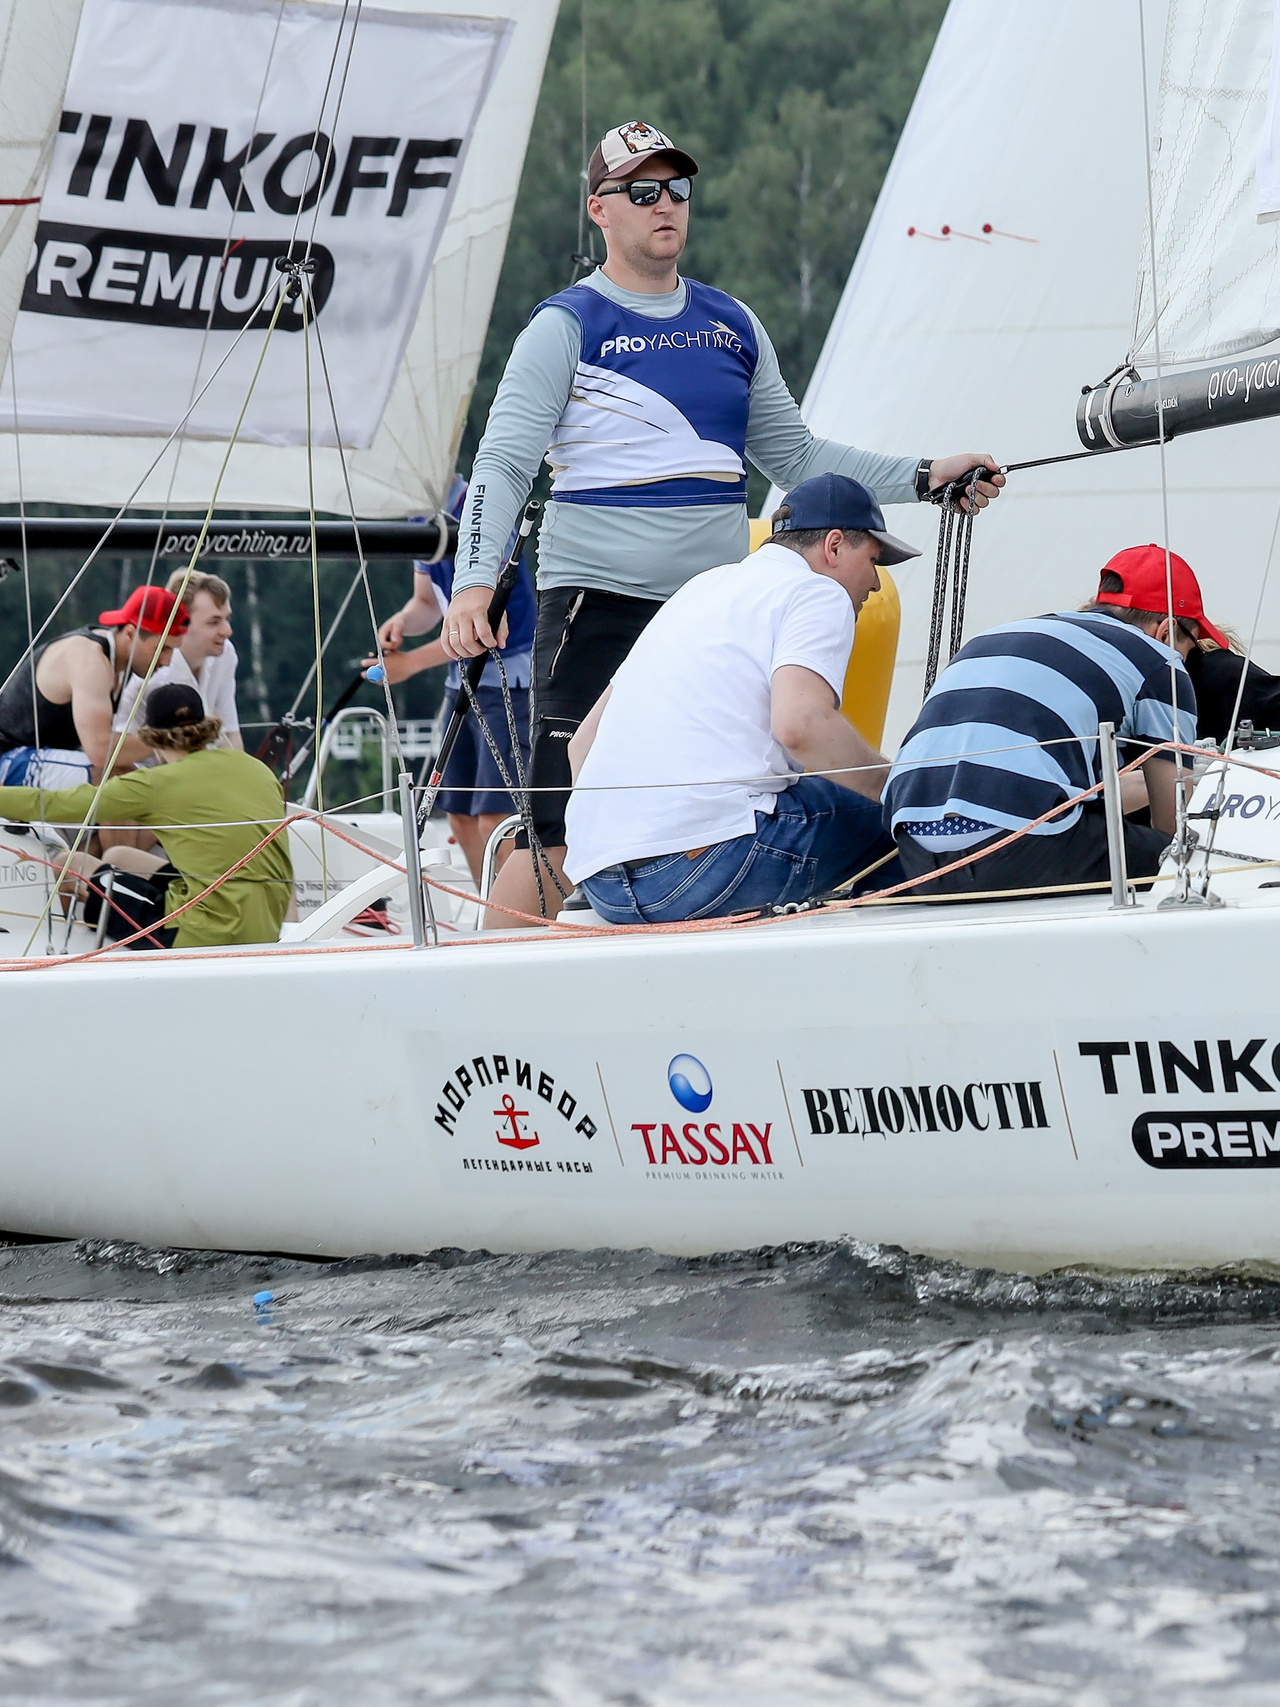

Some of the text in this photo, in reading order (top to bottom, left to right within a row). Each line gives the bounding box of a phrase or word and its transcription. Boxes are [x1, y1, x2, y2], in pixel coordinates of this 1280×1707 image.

[59, 111, 463, 217] INKOFF
[27, 240, 316, 314] REMIUM
[600, 330, 742, 358] PROYACHTING
[469, 484, 486, 570] FINNTRAIL
[434, 1055, 598, 1140] МОРПРИБОР
[800, 1080, 1051, 1141] ВЕДОМОСТИ
[463, 1158, 593, 1173] ЛЕГЕНДАРНЫЕ ЧАСЫ
[631, 1123, 774, 1165] TASSAY
[645, 1171, 785, 1180] PREMIUM DRINKING WATER
